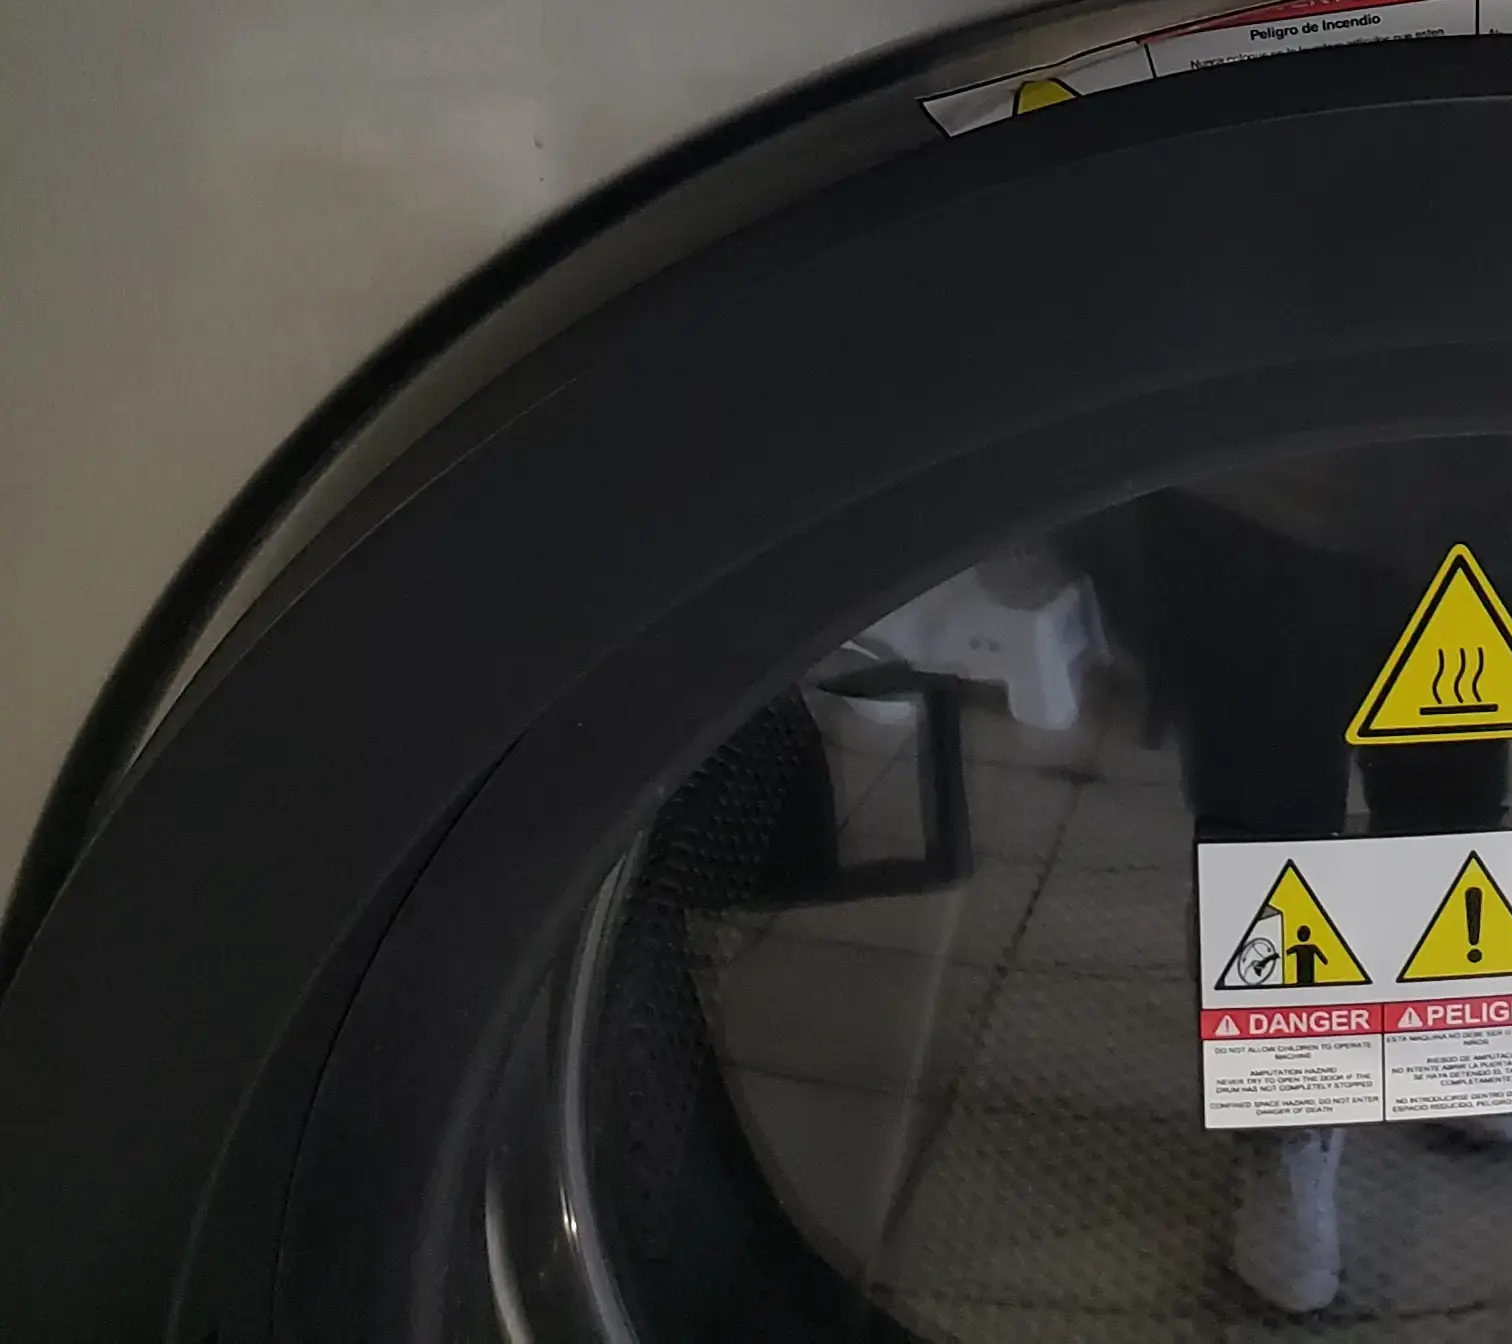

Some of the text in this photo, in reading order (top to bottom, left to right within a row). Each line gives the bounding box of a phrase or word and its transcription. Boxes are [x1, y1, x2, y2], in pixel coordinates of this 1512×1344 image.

[1249, 12, 1382, 42] Peligro de Incendio
[1249, 1009, 1370, 1035] DANGER
